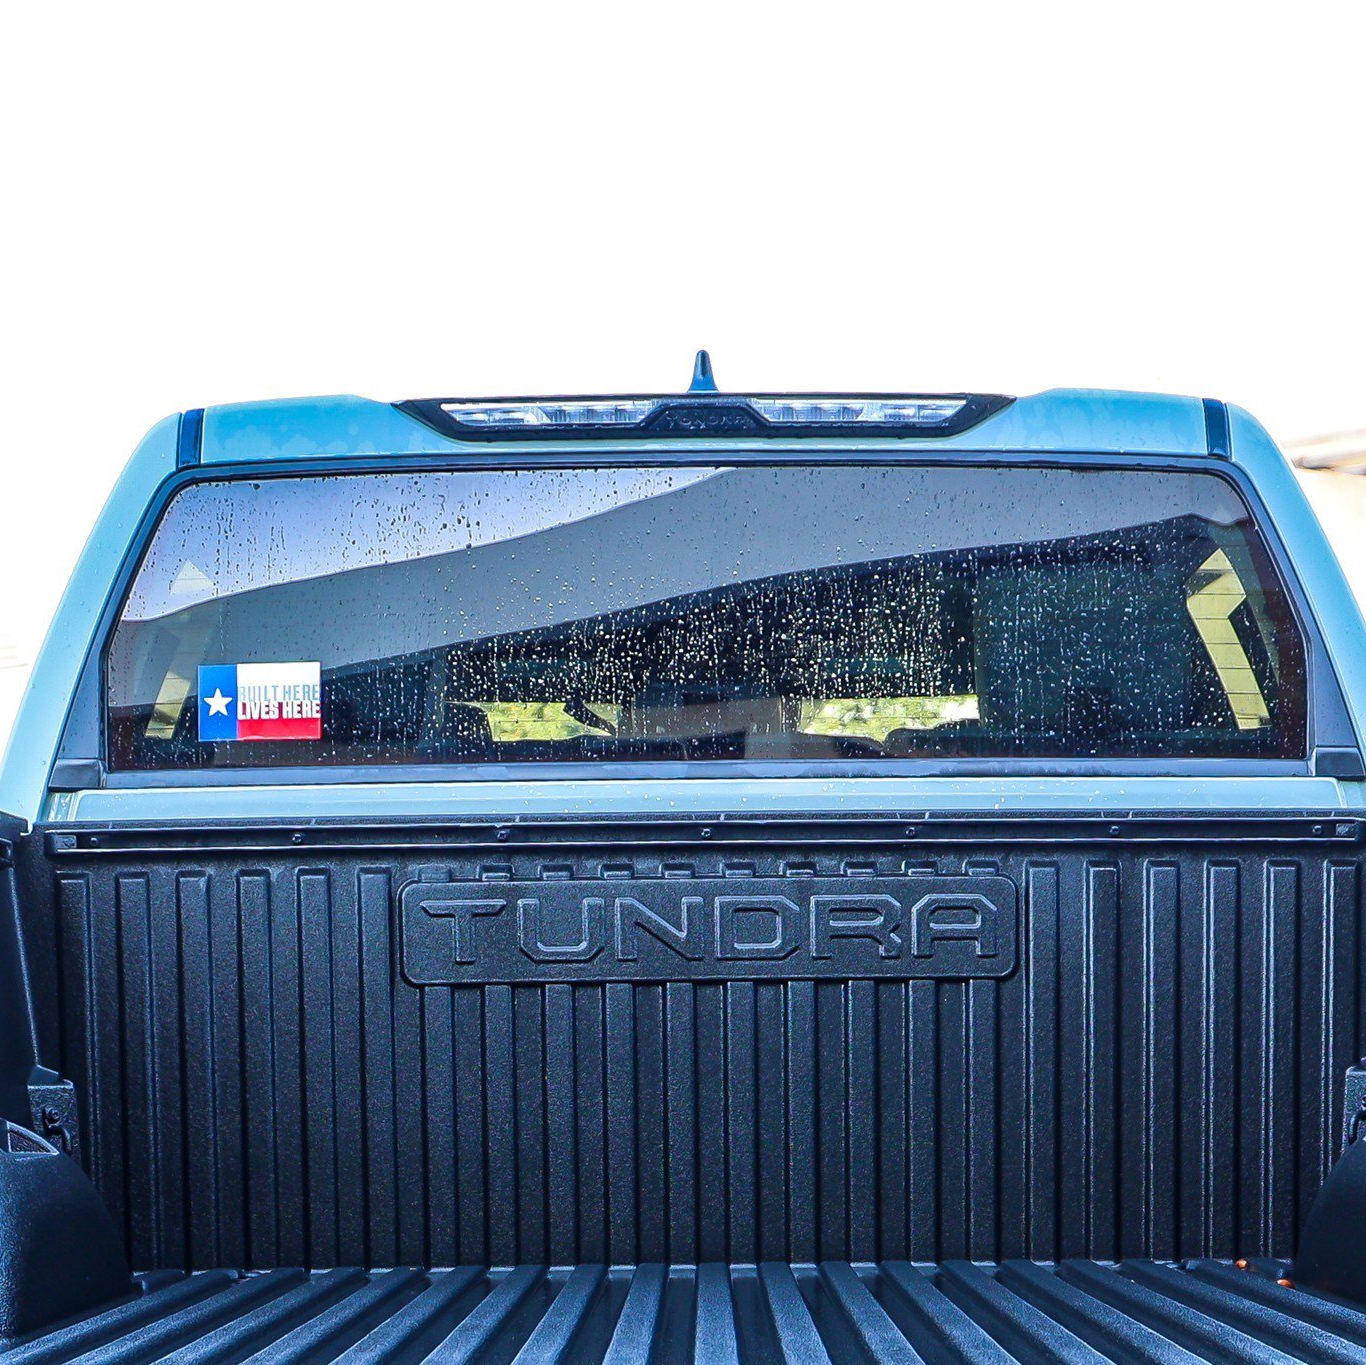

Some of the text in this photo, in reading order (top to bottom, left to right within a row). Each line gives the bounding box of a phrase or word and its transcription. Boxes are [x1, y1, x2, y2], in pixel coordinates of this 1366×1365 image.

[238, 684, 321, 701] BUILT HERE
[237, 700, 322, 720] LIVES HERE
[418, 894, 999, 964] TUNDRA
